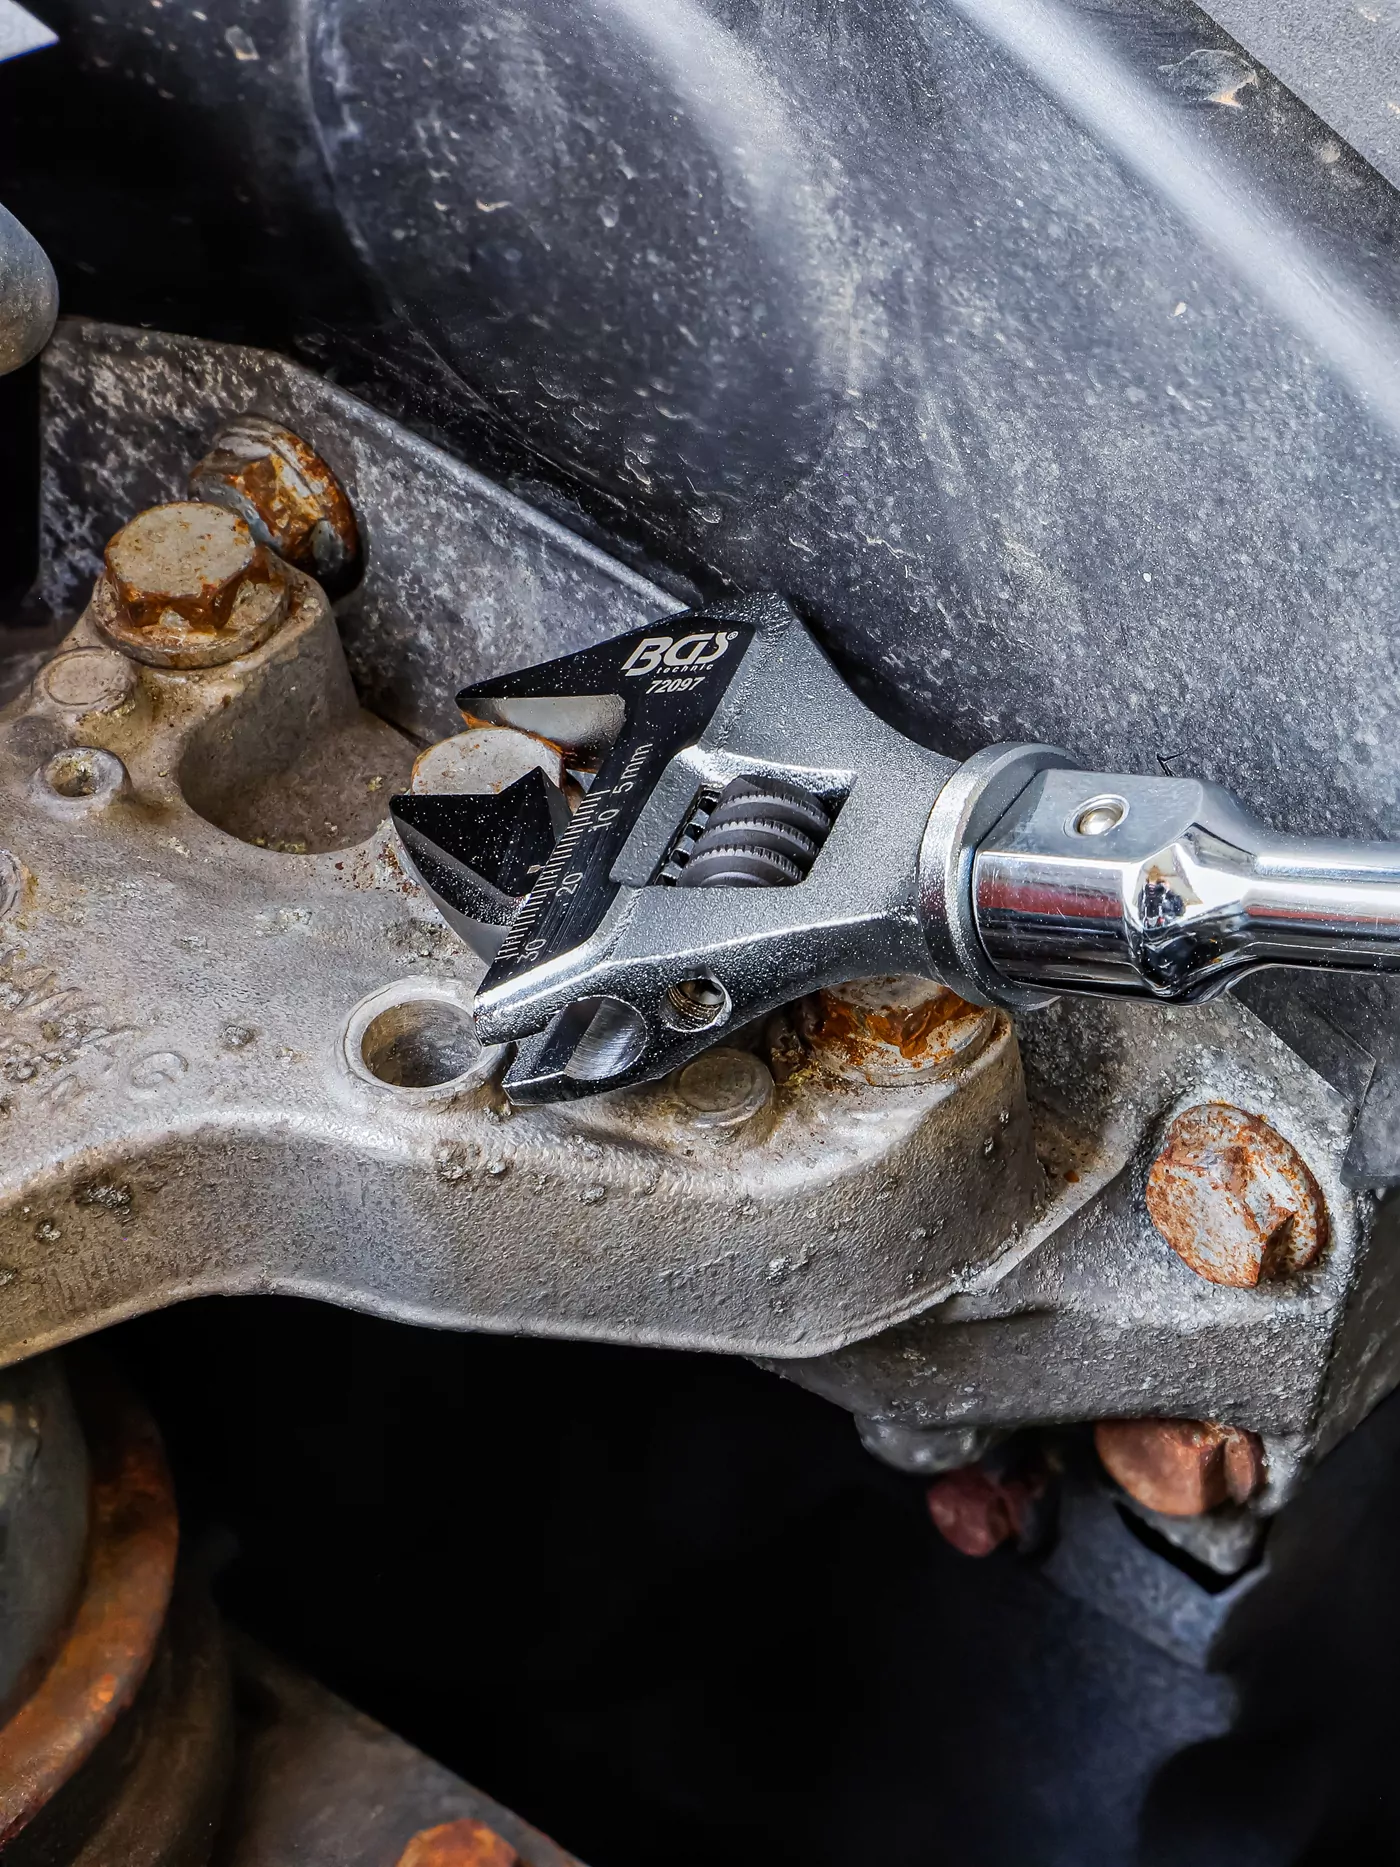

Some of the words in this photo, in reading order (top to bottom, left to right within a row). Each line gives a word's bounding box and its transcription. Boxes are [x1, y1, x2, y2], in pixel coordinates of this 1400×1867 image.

[656, 663, 714, 674] technic
[645, 676, 706, 695] 72097
[592, 808, 620, 832] 10
[555, 872, 583, 897] 20
[516, 939, 547, 963] 30
